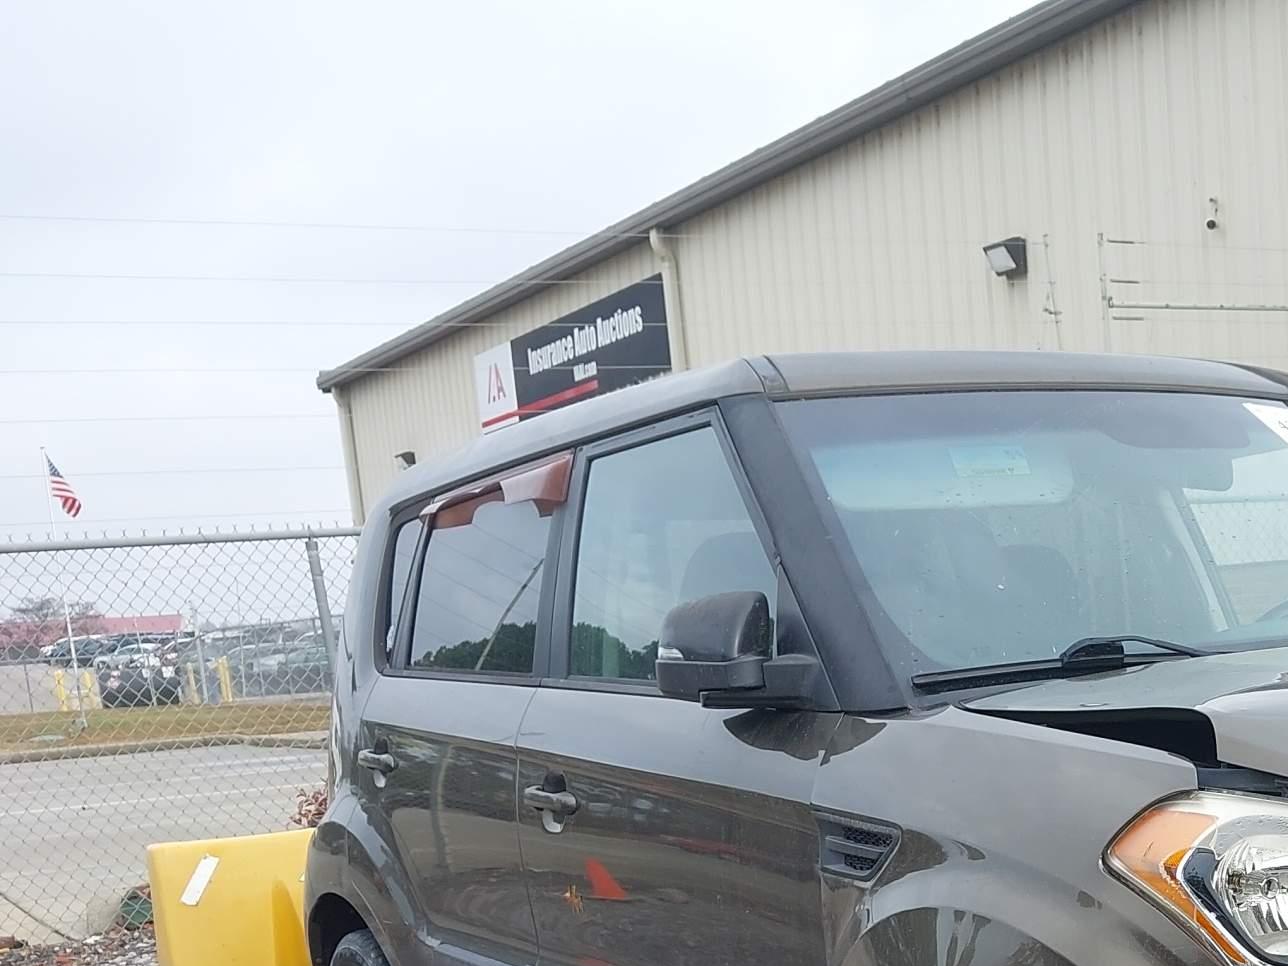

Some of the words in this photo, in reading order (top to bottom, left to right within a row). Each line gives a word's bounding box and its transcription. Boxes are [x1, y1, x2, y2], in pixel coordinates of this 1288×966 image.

[527, 335, 574, 376] Insurance
[573, 324, 597, 357] Auto
[596, 305, 643, 348] Auctions
